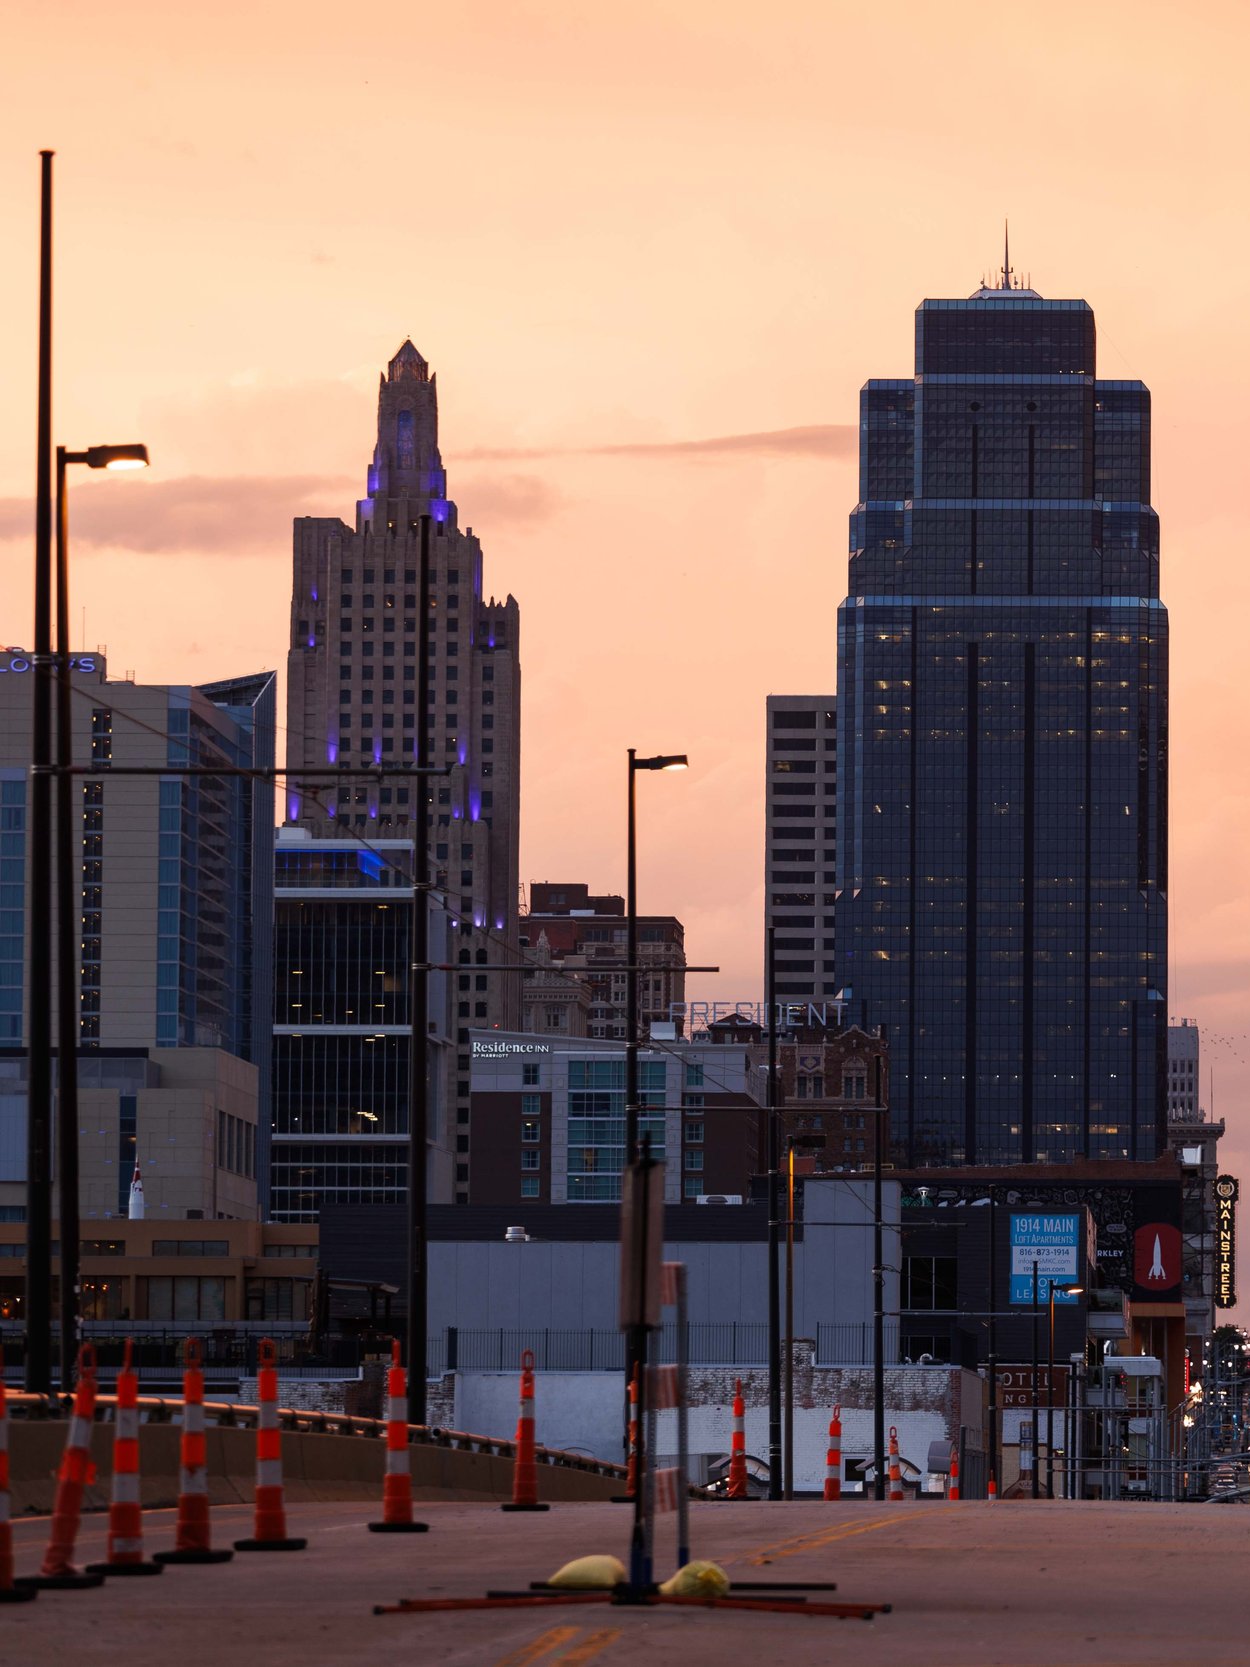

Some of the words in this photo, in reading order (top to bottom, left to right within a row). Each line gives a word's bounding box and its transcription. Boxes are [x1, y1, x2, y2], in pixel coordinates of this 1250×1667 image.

[669, 1001, 848, 1026] PRESIDENT
[472, 1041, 533, 1053] Residence
[1015, 1218, 1041, 1232] 1914
[1043, 1218, 1074, 1232] MAIN
[1019, 1248, 1070, 1256] 816-873-1914
[1220, 1200, 1231, 1305] MAINSTREET
[1016, 1289, 1071, 1298] LESNG
